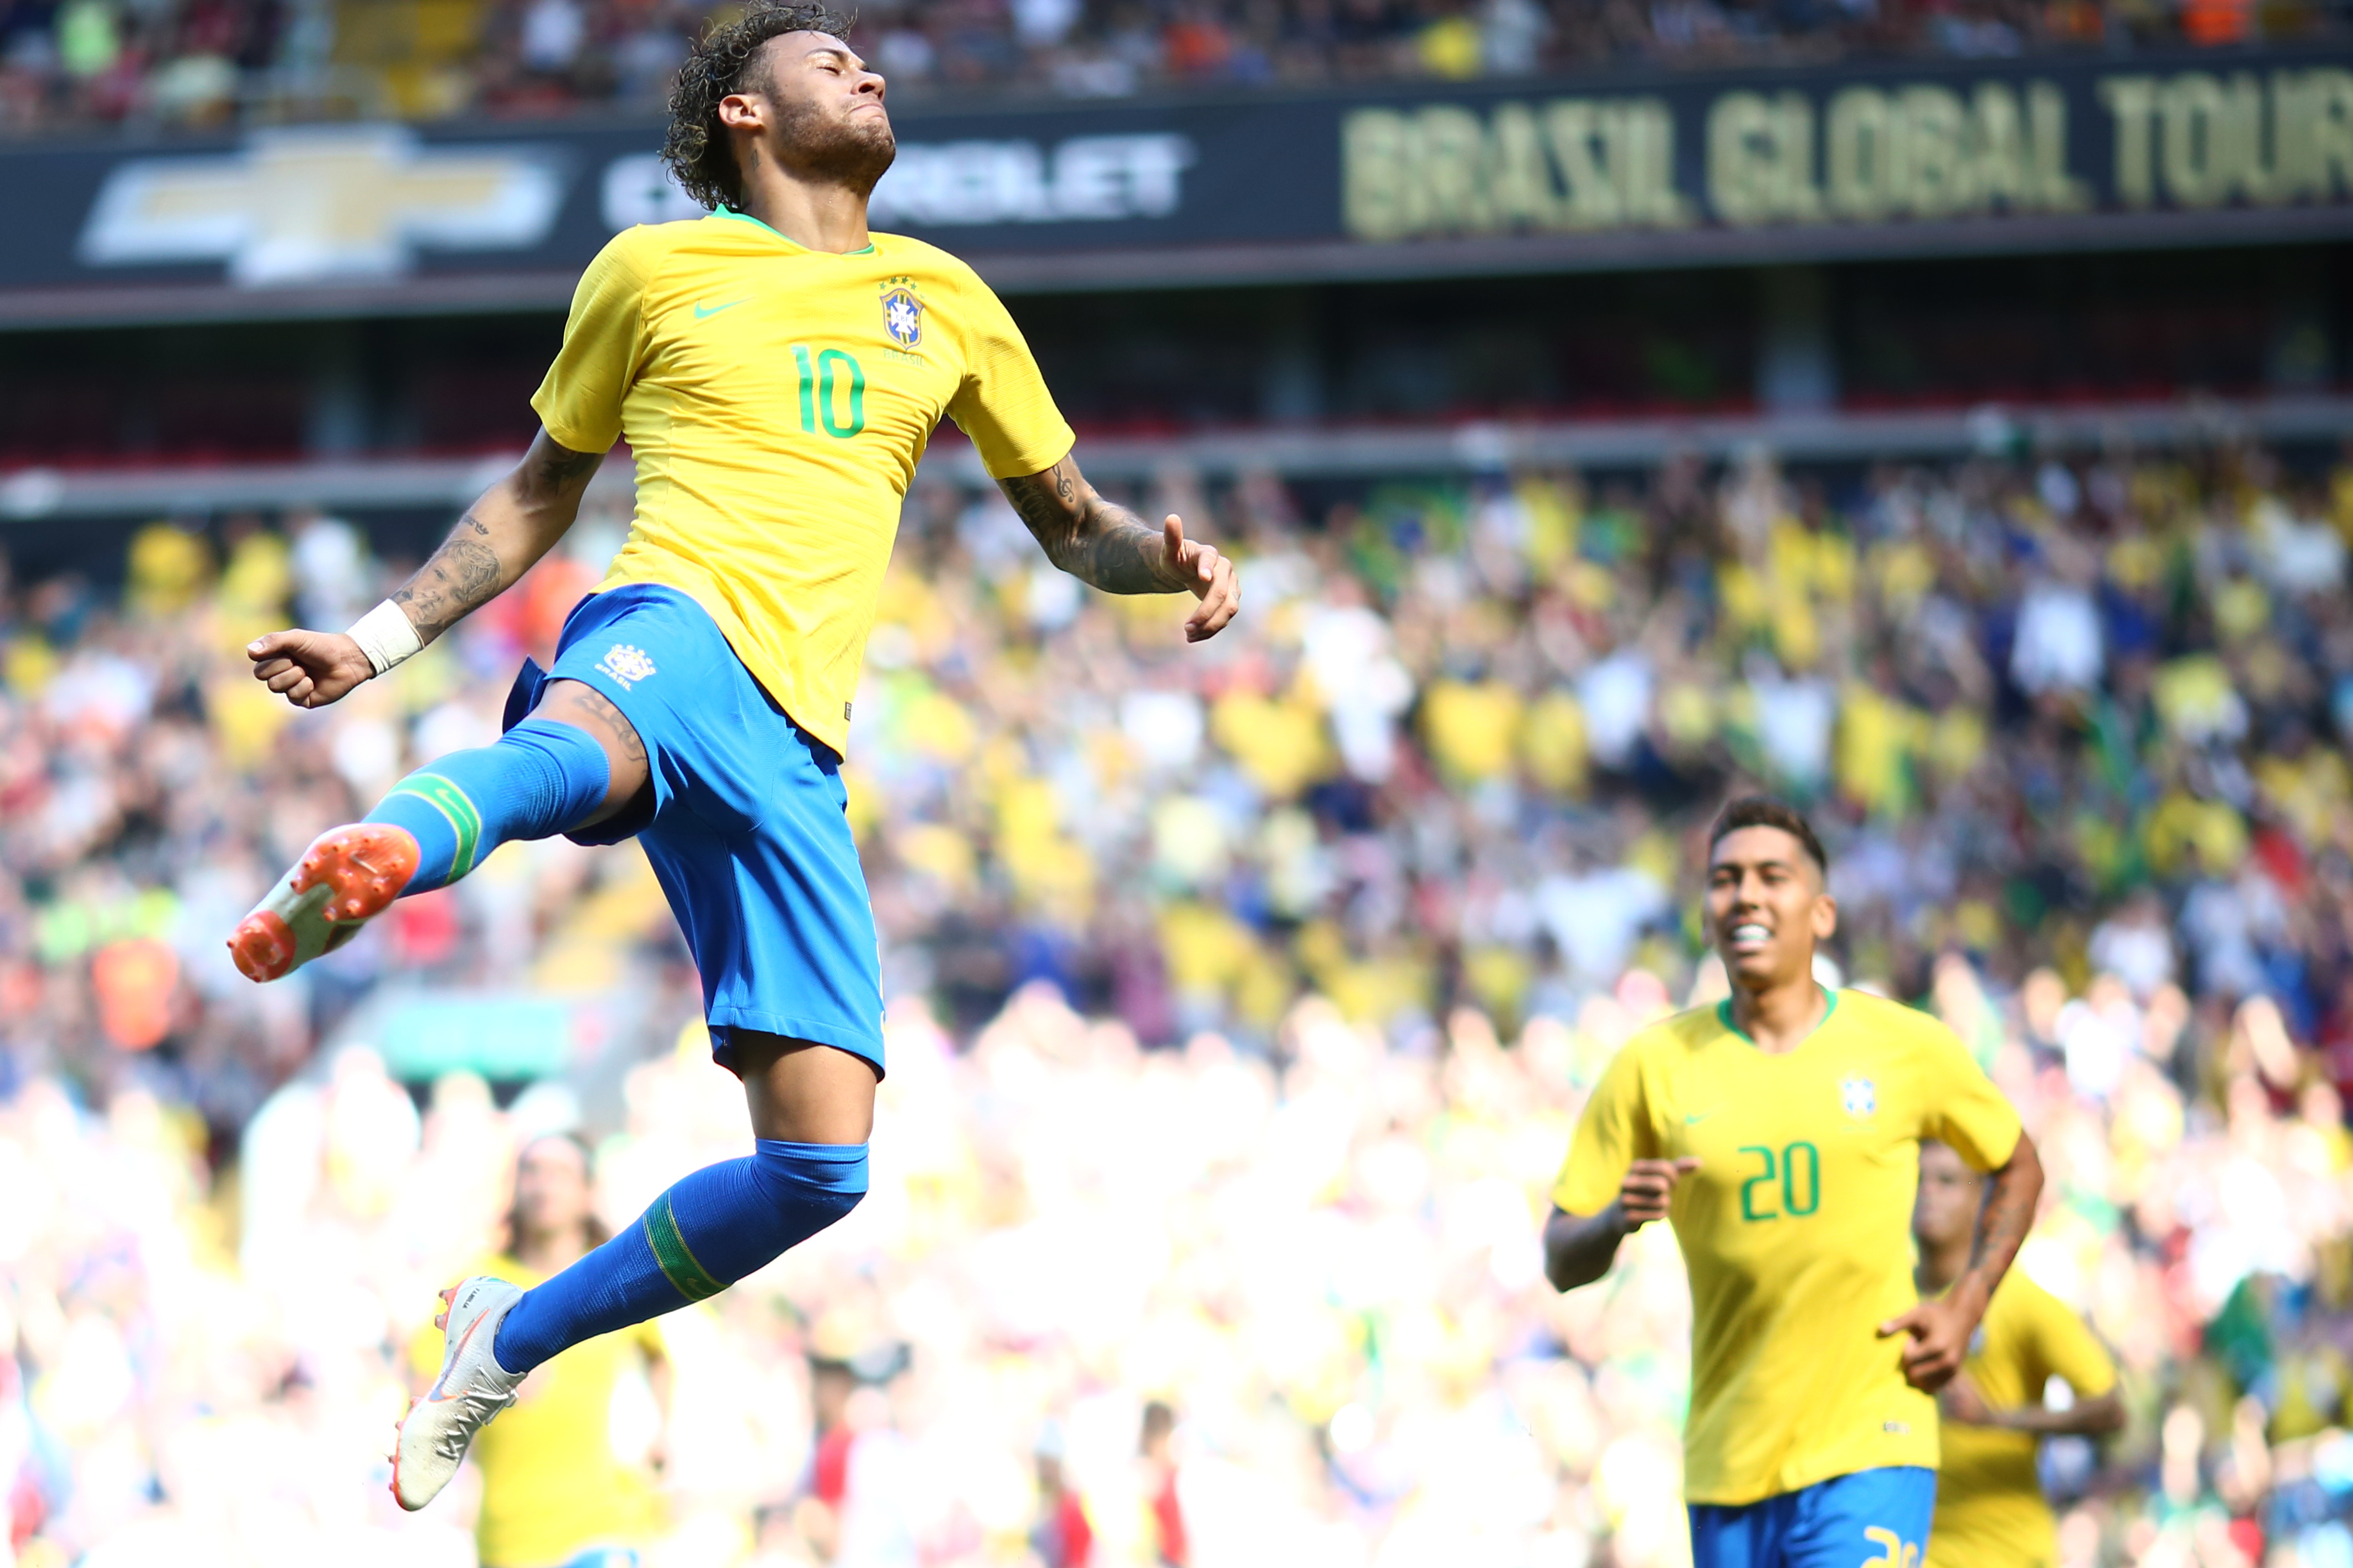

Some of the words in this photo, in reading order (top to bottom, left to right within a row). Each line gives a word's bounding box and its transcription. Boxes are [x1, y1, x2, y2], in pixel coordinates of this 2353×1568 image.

[600, 132, 1197, 233] CROLET
[1341, 96, 1694, 241] BRASIL
[1705, 78, 2091, 224] GLOBAL
[883, 348, 926, 367] BRASIL
[896, 314, 909, 323] CBF
[790, 345, 865, 439] 10
[594, 663, 631, 691] BRASIL
[1737, 1141, 1820, 1222] 20
